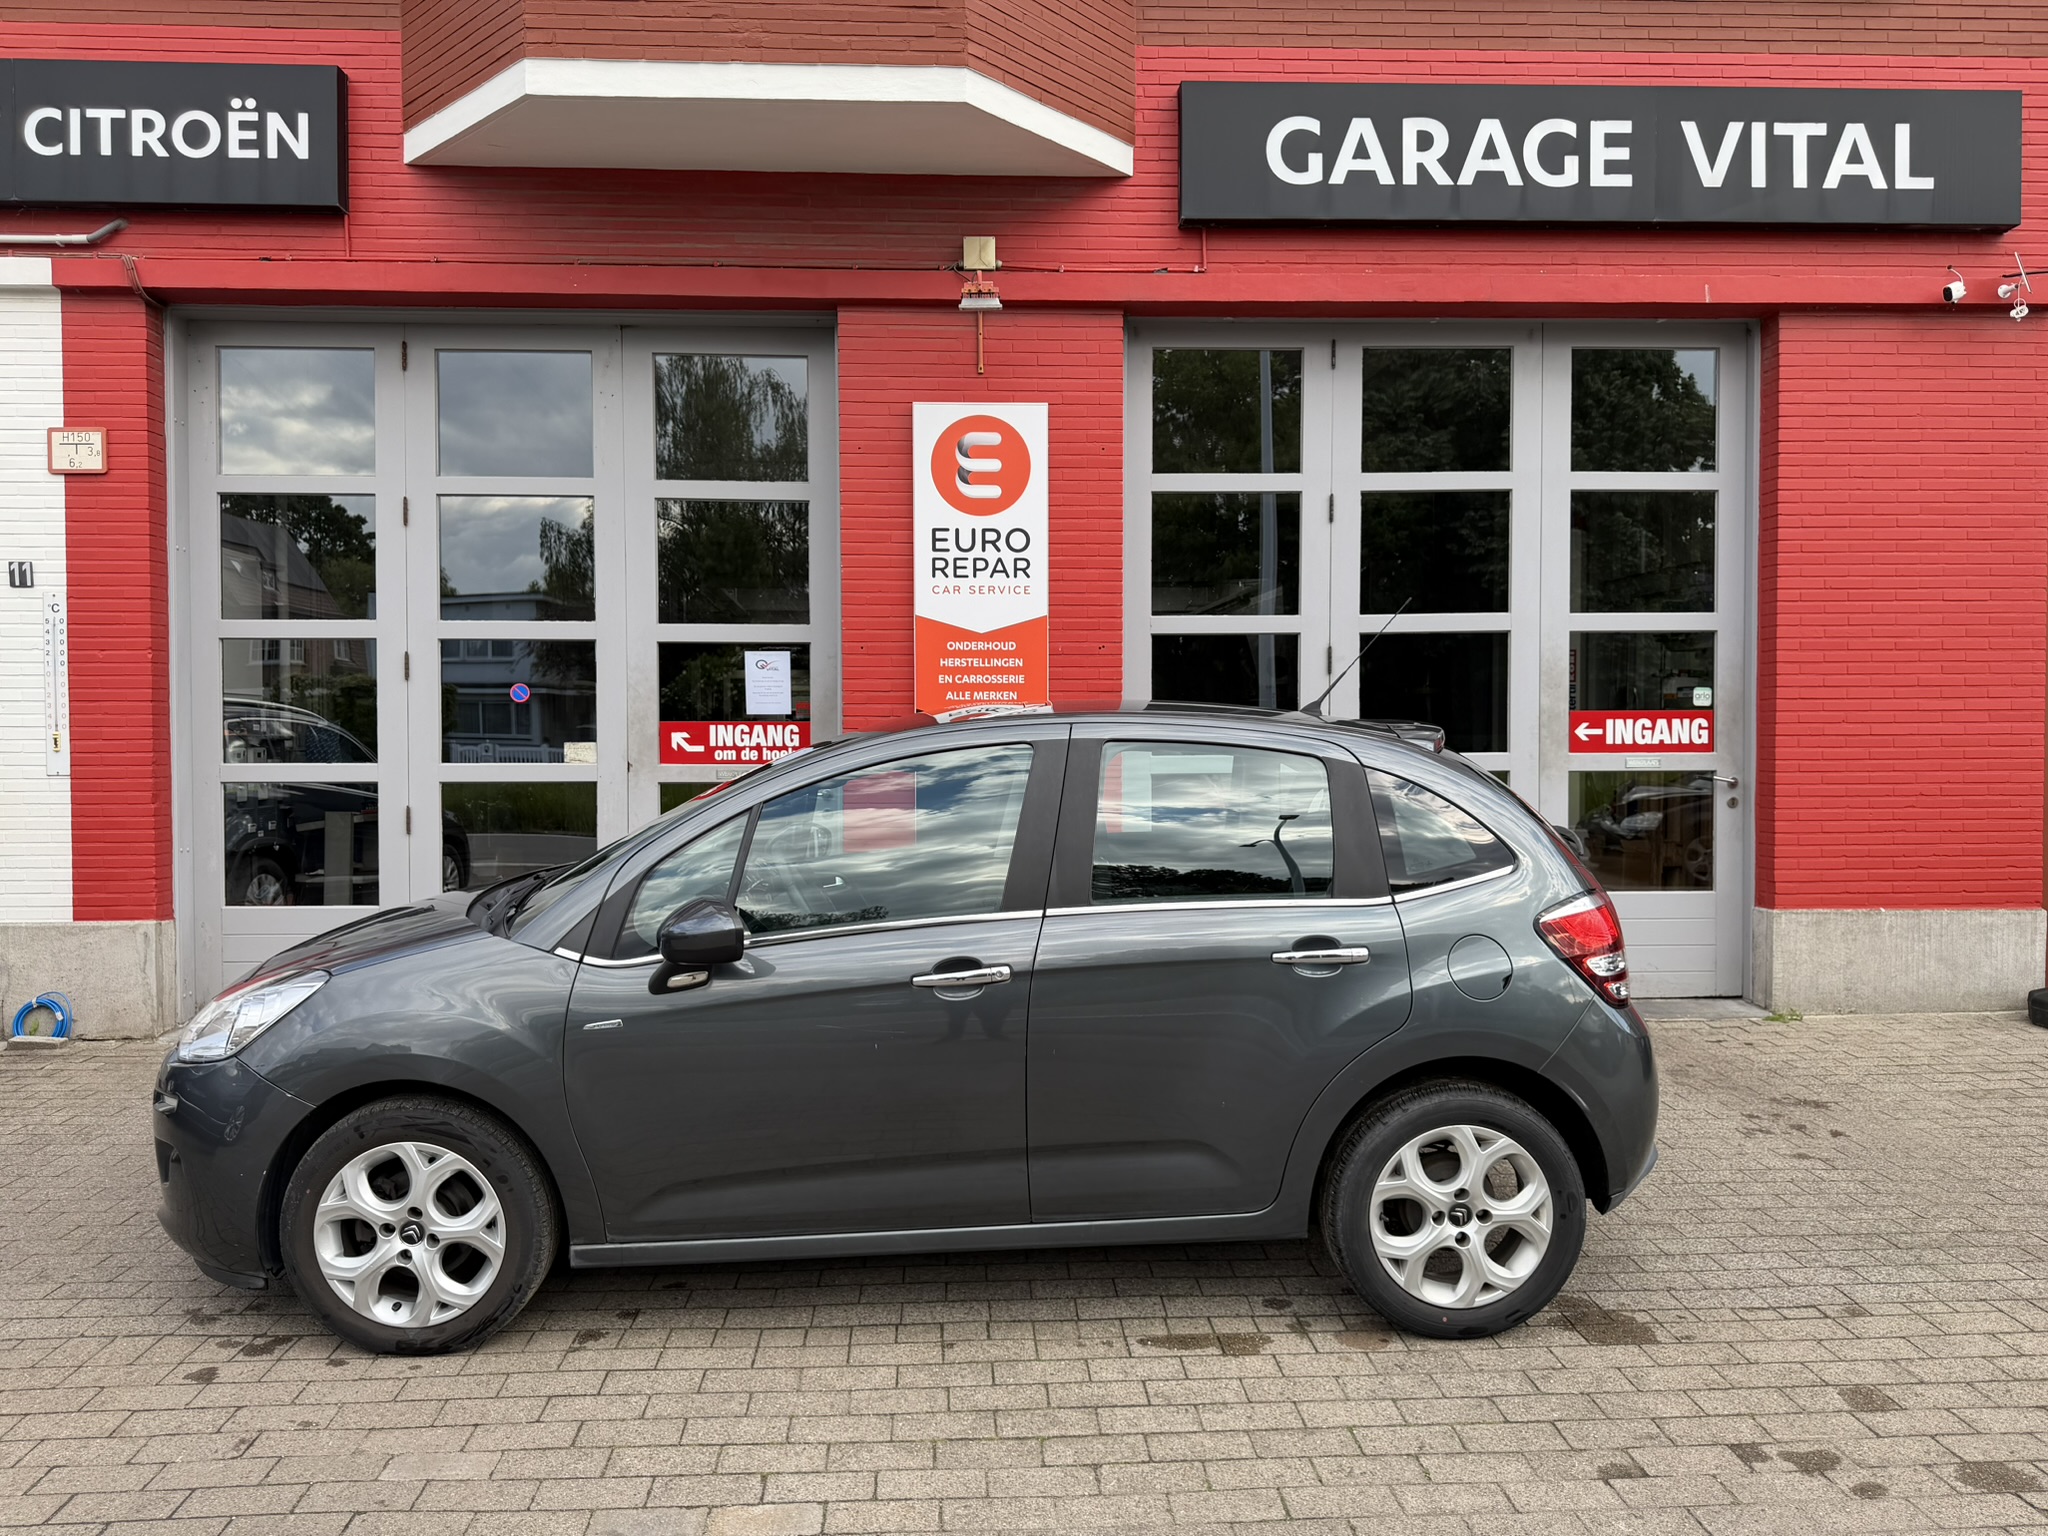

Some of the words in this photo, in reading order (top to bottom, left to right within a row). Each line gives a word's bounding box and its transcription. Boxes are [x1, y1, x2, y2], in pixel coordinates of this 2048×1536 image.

[24, 98, 309, 160] CITROËN
[1265, 115, 1634, 188] GARAGE
[1681, 119, 1935, 190] VITAL
[62, 433, 91, 442] H150
[931, 527, 1031, 553] EURO
[10, 562, 32, 587] 11
[931, 557, 1031, 578] REPAR
[931, 585, 961, 595] CAR
[968, 585, 1031, 595] SERVICE
[946, 641, 1017, 651] ONDERHOUD
[939, 658, 1024, 667] HERSTELLINGEN
[938, 674, 953, 684] EN
[955, 674, 1025, 684] CARROSSERIE
[945, 691, 971, 700] ALLE
[973, 691, 1018, 700] MERKEN
[709, 724, 800, 747] INGANG
[1605, 717, 1709, 745] INGANG
[714, 749, 737, 761] om
[740, 747, 759, 761] de
